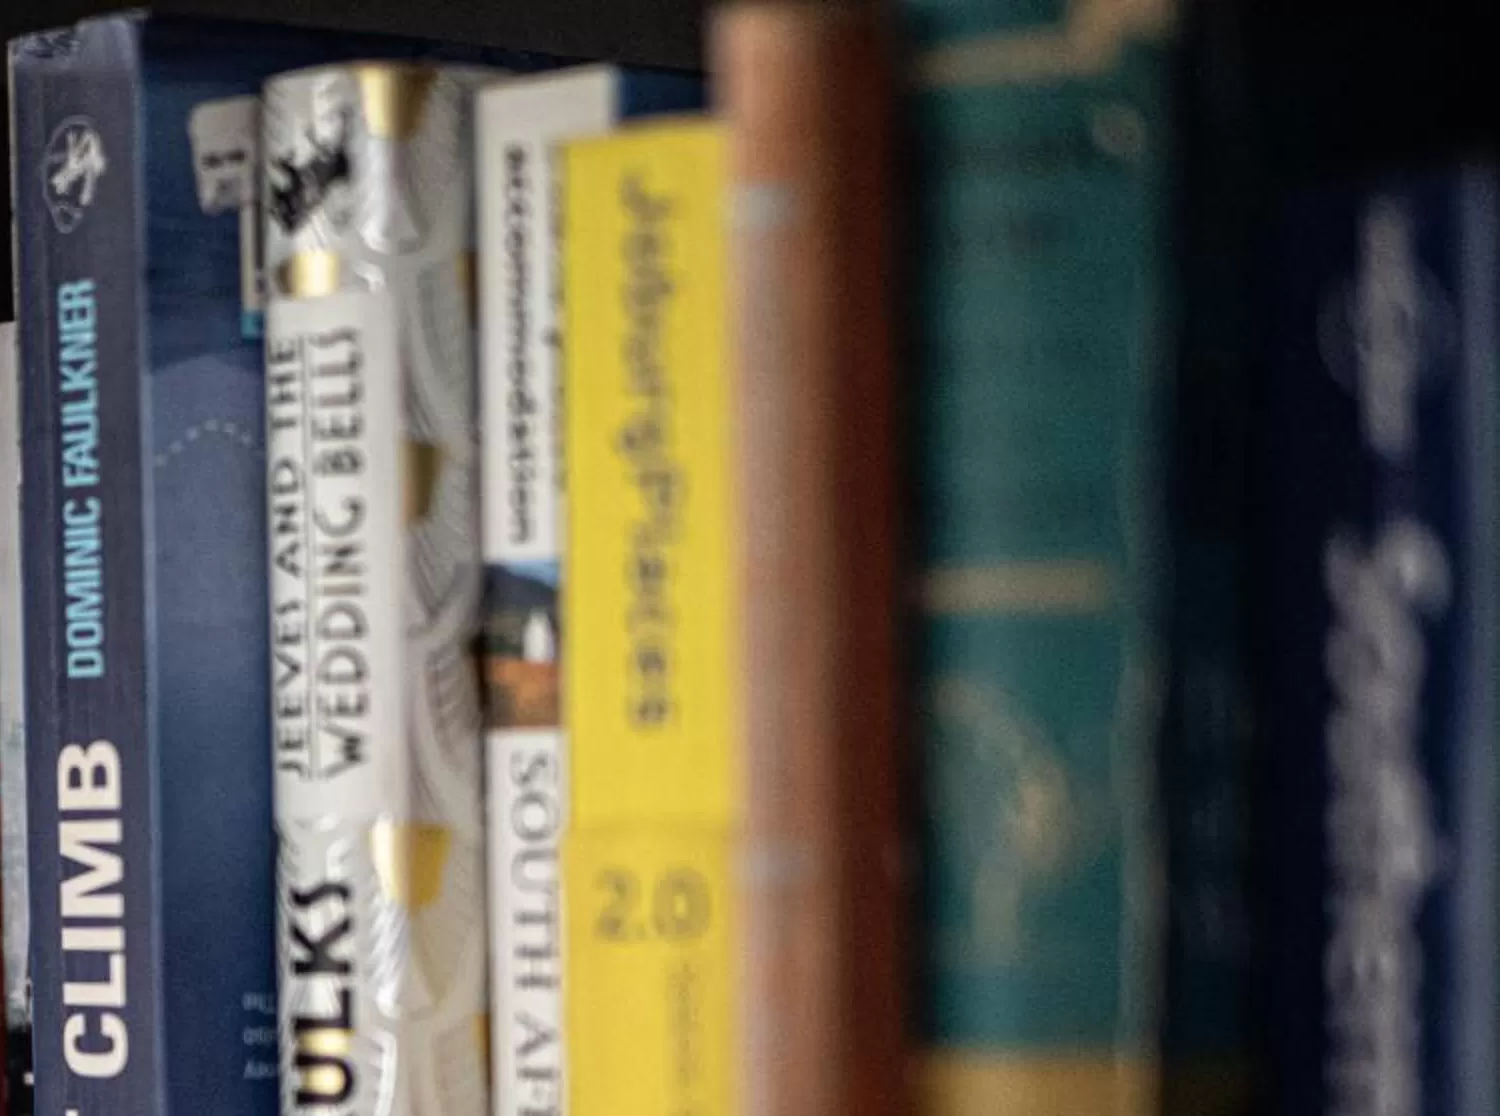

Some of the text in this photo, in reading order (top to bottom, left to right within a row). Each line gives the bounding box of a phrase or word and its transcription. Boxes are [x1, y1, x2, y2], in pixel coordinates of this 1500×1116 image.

[57, 278, 105, 679] DOMINIC FAULKNER
[268, 334, 304, 778] JEEVES AND THE
[309, 326, 370, 780] WEDDING BELLS
[57, 739, 129, 1079] CLIMB
[508, 747, 560, 991] SOUTH
[592, 862, 713, 942] 2.0
